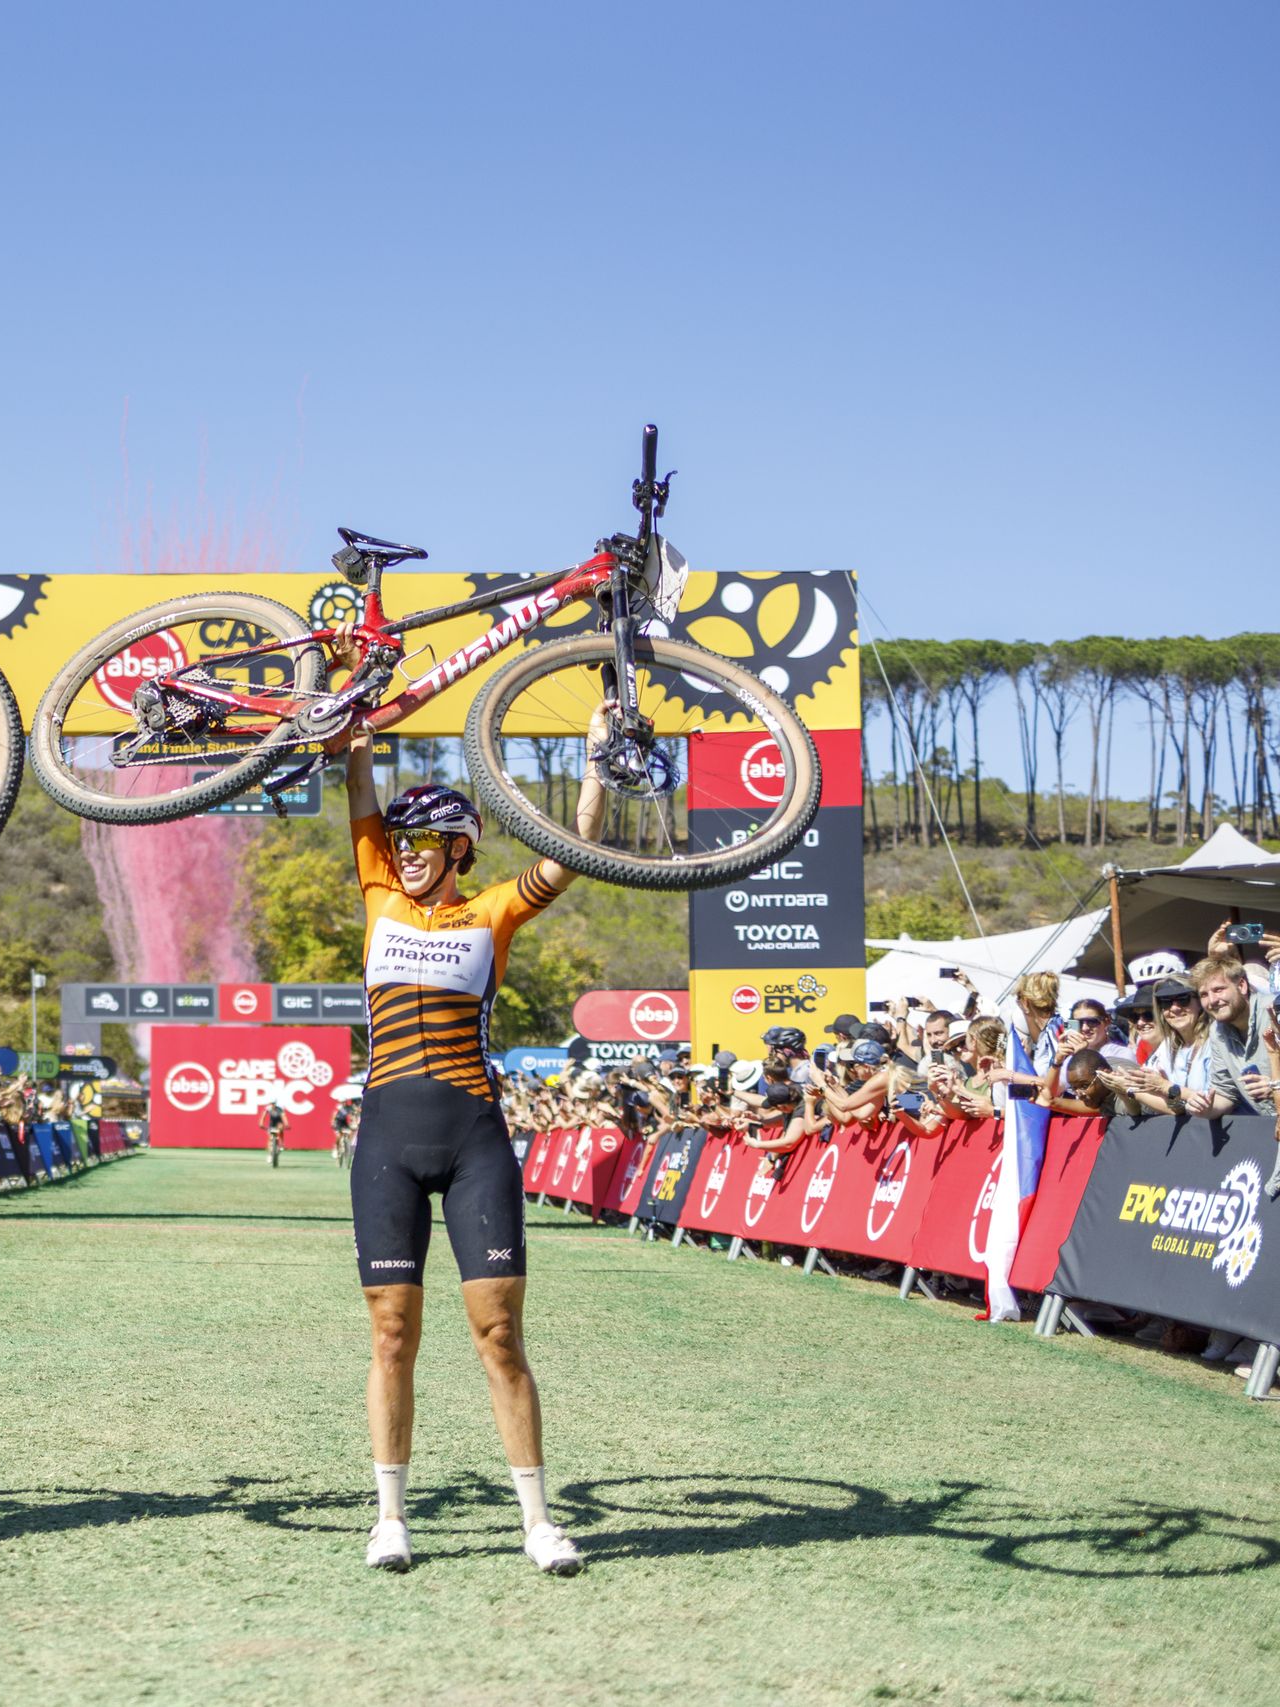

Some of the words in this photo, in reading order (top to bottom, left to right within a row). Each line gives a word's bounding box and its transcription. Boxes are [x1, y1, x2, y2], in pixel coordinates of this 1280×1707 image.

[106, 649, 170, 678] absa
[748, 757, 786, 779] abs
[430, 803, 461, 822] GIRO
[734, 924, 820, 942] TOYOTA
[385, 947, 460, 965] maxon
[764, 984, 795, 994] CAPE
[283, 996, 312, 1008] GIC
[764, 995, 817, 1014] EPIC
[636, 1006, 673, 1022] absa
[587, 1043, 661, 1058] TOYOTA
[219, 1060, 276, 1078] CAPE
[171, 1076, 210, 1094] absa
[218, 1079, 314, 1115] EPIC
[808, 1170, 832, 1198] absa
[1119, 1183, 1167, 1224] EPIC
[1159, 1188, 1241, 1236] SERIES
[1151, 1234, 1189, 1255] GLOBAL
[1191, 1240, 1216, 1259] MTB
[371, 1259, 416, 1270] maxon
